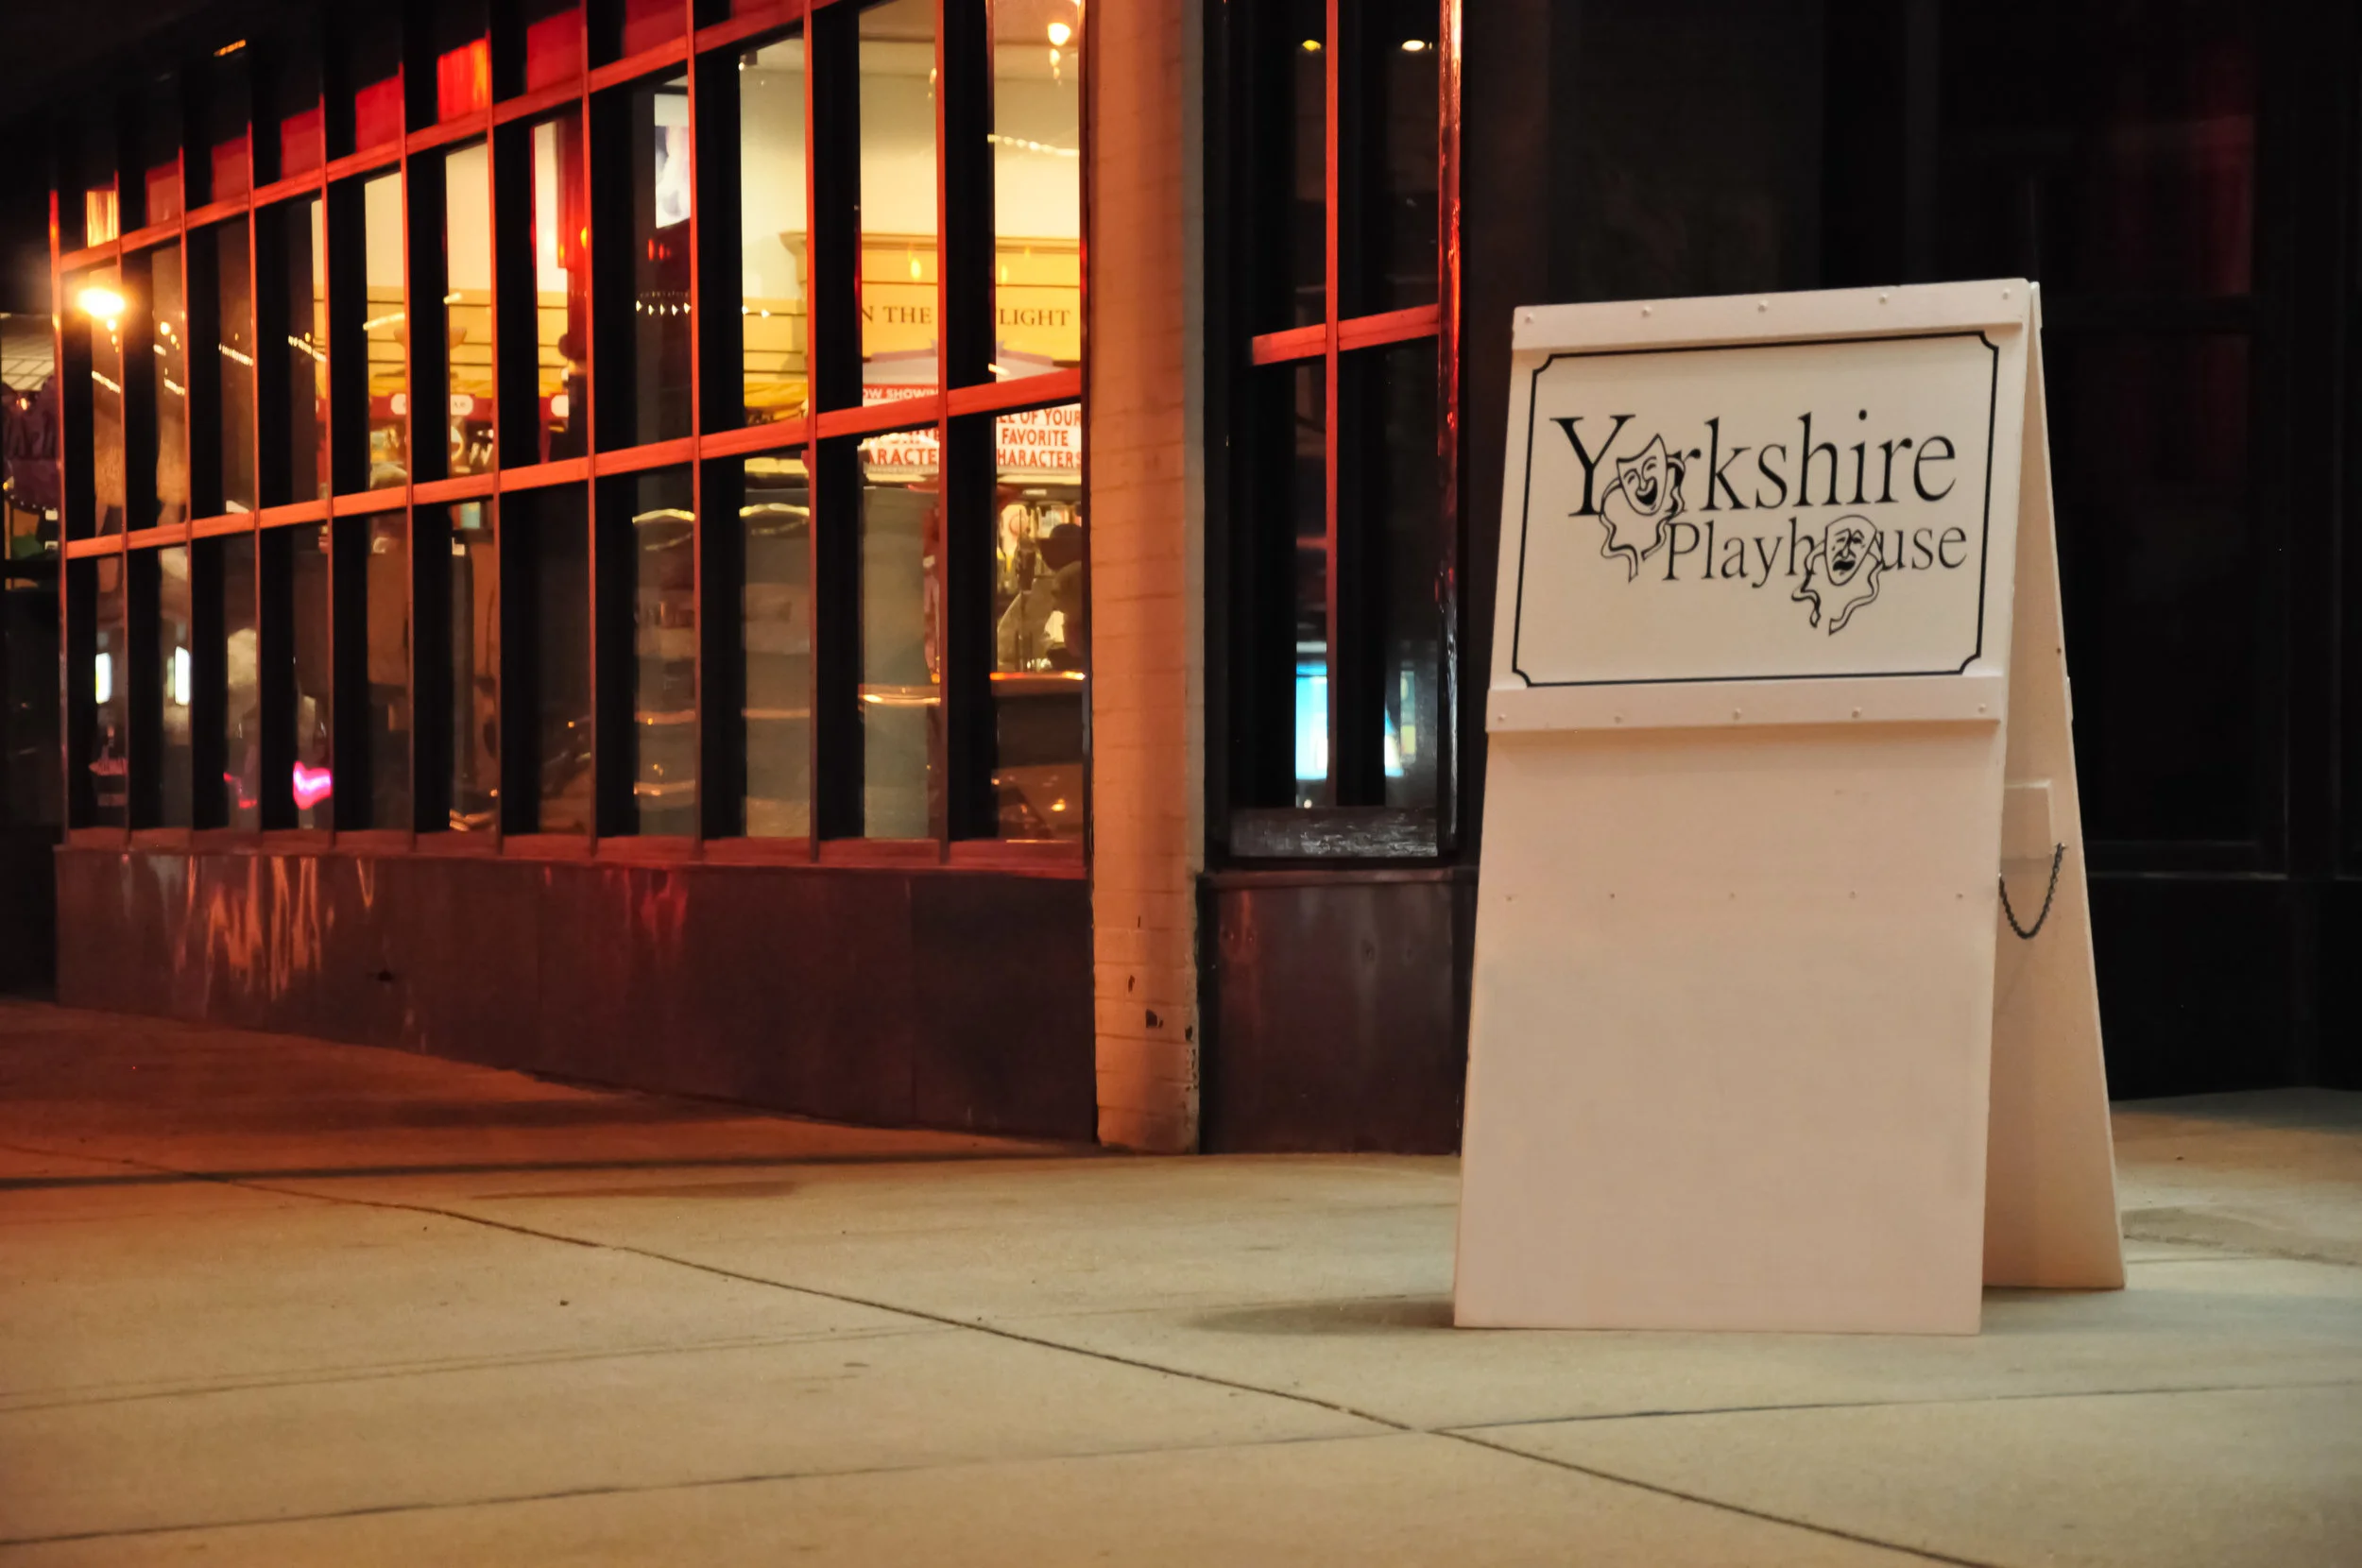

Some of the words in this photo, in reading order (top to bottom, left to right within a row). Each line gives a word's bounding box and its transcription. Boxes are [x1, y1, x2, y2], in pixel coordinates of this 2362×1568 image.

[862, 305, 873, 323] N
[882, 306, 932, 324] THE
[999, 308, 1071, 326] LIGHT
[863, 388, 882, 399] OW
[1044, 407, 1081, 427] YOUR
[1001, 428, 1069, 447] FAVORITE
[868, 448, 937, 466] ARACTE
[997, 449, 1081, 468] HARACTERS
[1549, 408, 1959, 519] Yorkshire
[1661, 515, 1968, 588] Playhouse
